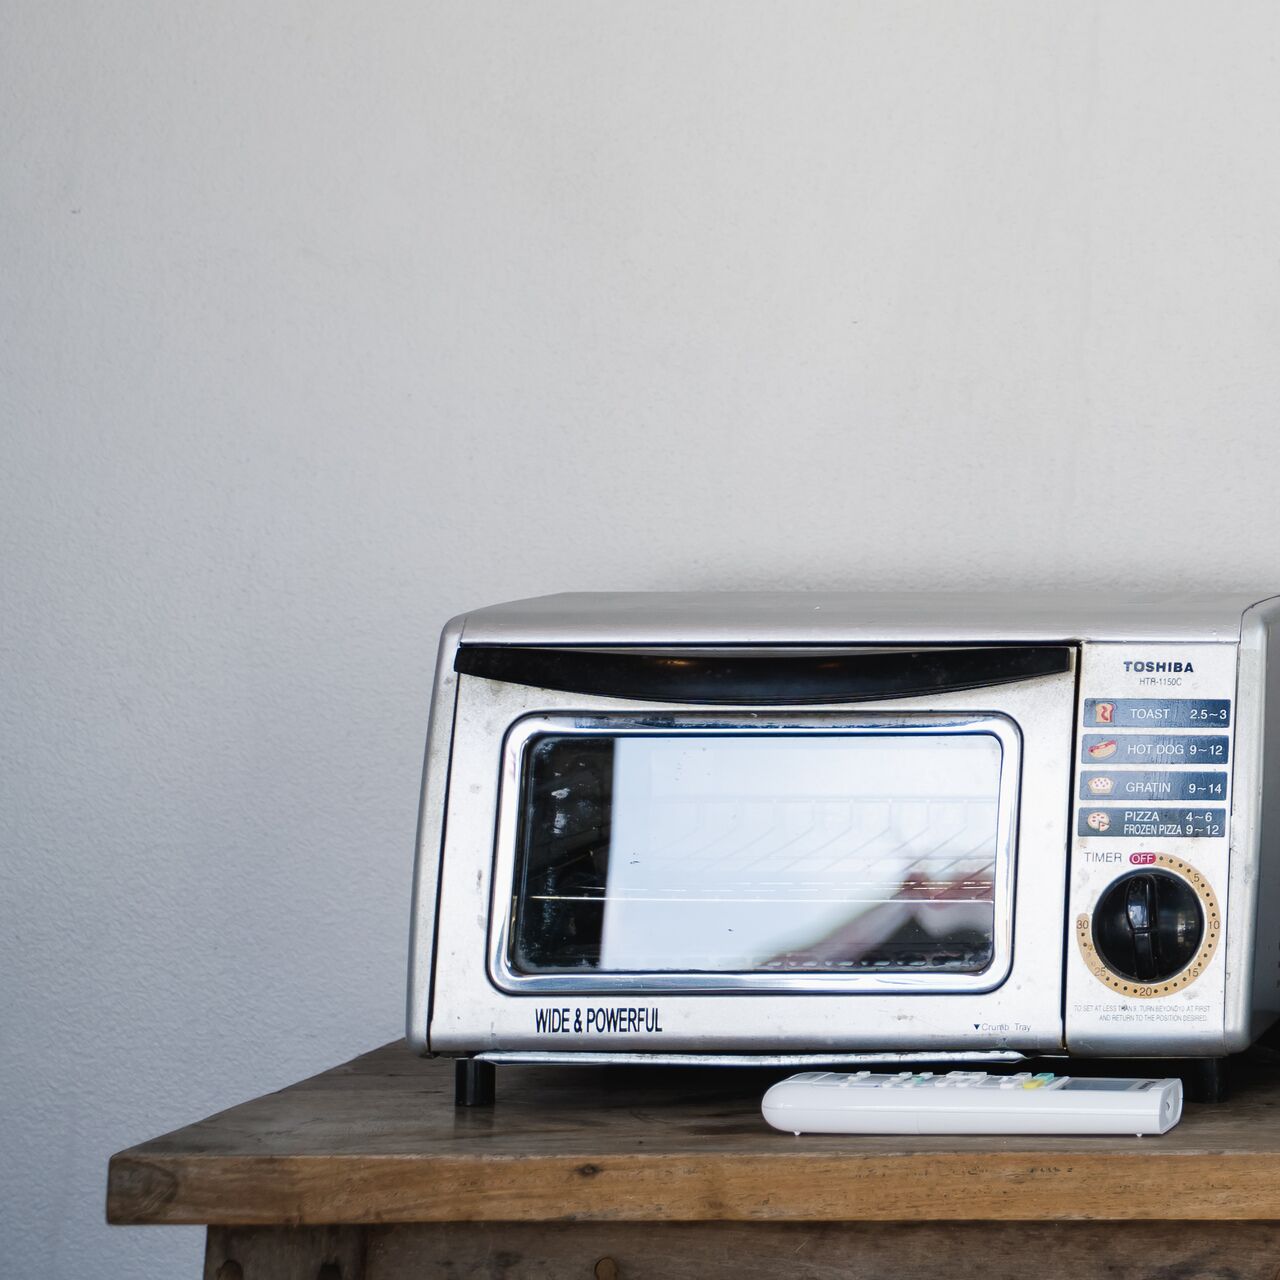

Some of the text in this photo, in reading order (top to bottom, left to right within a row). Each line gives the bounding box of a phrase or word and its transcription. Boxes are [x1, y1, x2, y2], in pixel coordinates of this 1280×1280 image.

[1123, 661, 1194, 673] TOSHIBA
[1139, 677, 1183, 686] HTR-1150C
[1130, 708, 1171, 719] TOAST
[1127, 744, 1154, 755] HOT
[1156, 744, 1185, 756] DOG
[1125, 782, 1171, 793] GRATIN
[1124, 811, 1160, 822] PIZZA
[1123, 824, 1157, 835] FROZEN
[1158, 824, 1182, 835] PIZZA
[1084, 852, 1154, 864] TIMER OFF
[1193, 874, 1200, 883] 5
[1076, 920, 1089, 930] 30
[1208, 920, 1221, 930] 10
[1094, 966, 1106, 977] 25
[1187, 968, 1199, 978] 15
[1139, 987, 1152, 997] 20
[1102, 1004, 1117, 1012] LESS
[535, 1007, 663, 1033] WIDE & POWERFUL
[1099, 1014, 1111, 1022] AND
[1112, 1014, 1134, 1022] RETURN
[1144, 1014, 1155, 1022] THE
[1156, 1014, 1182, 1022] POSITION
[981, 1022, 1032, 1032] Crumb Tray
